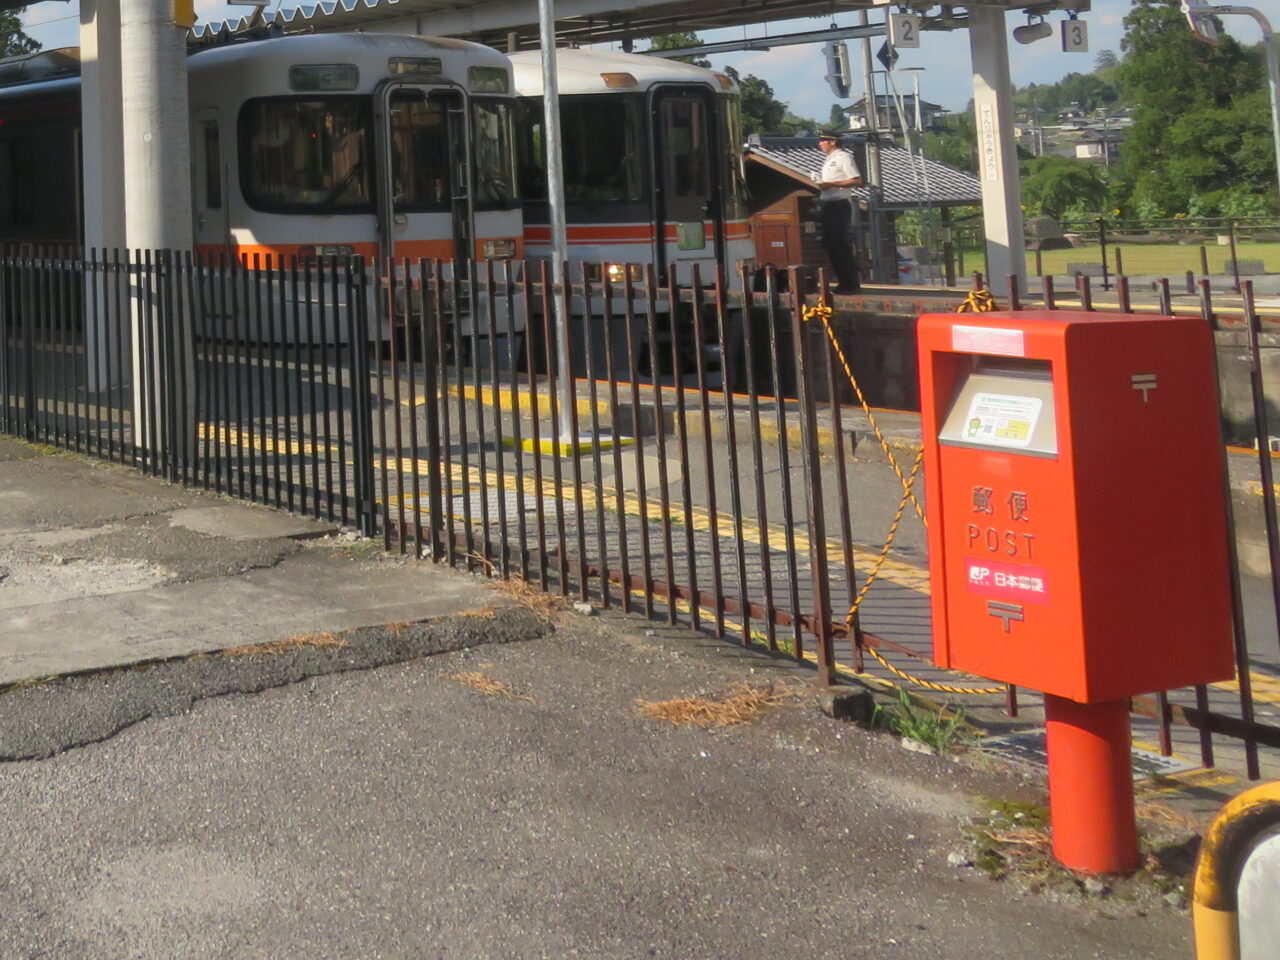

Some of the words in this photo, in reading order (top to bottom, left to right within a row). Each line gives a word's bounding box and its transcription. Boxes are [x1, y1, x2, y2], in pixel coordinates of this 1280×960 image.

[902, 21, 913, 41] 2
[1071, 26, 1083, 46] 3
[972, 486, 1029, 522] 郵便
[967, 523, 1035, 560] POST
